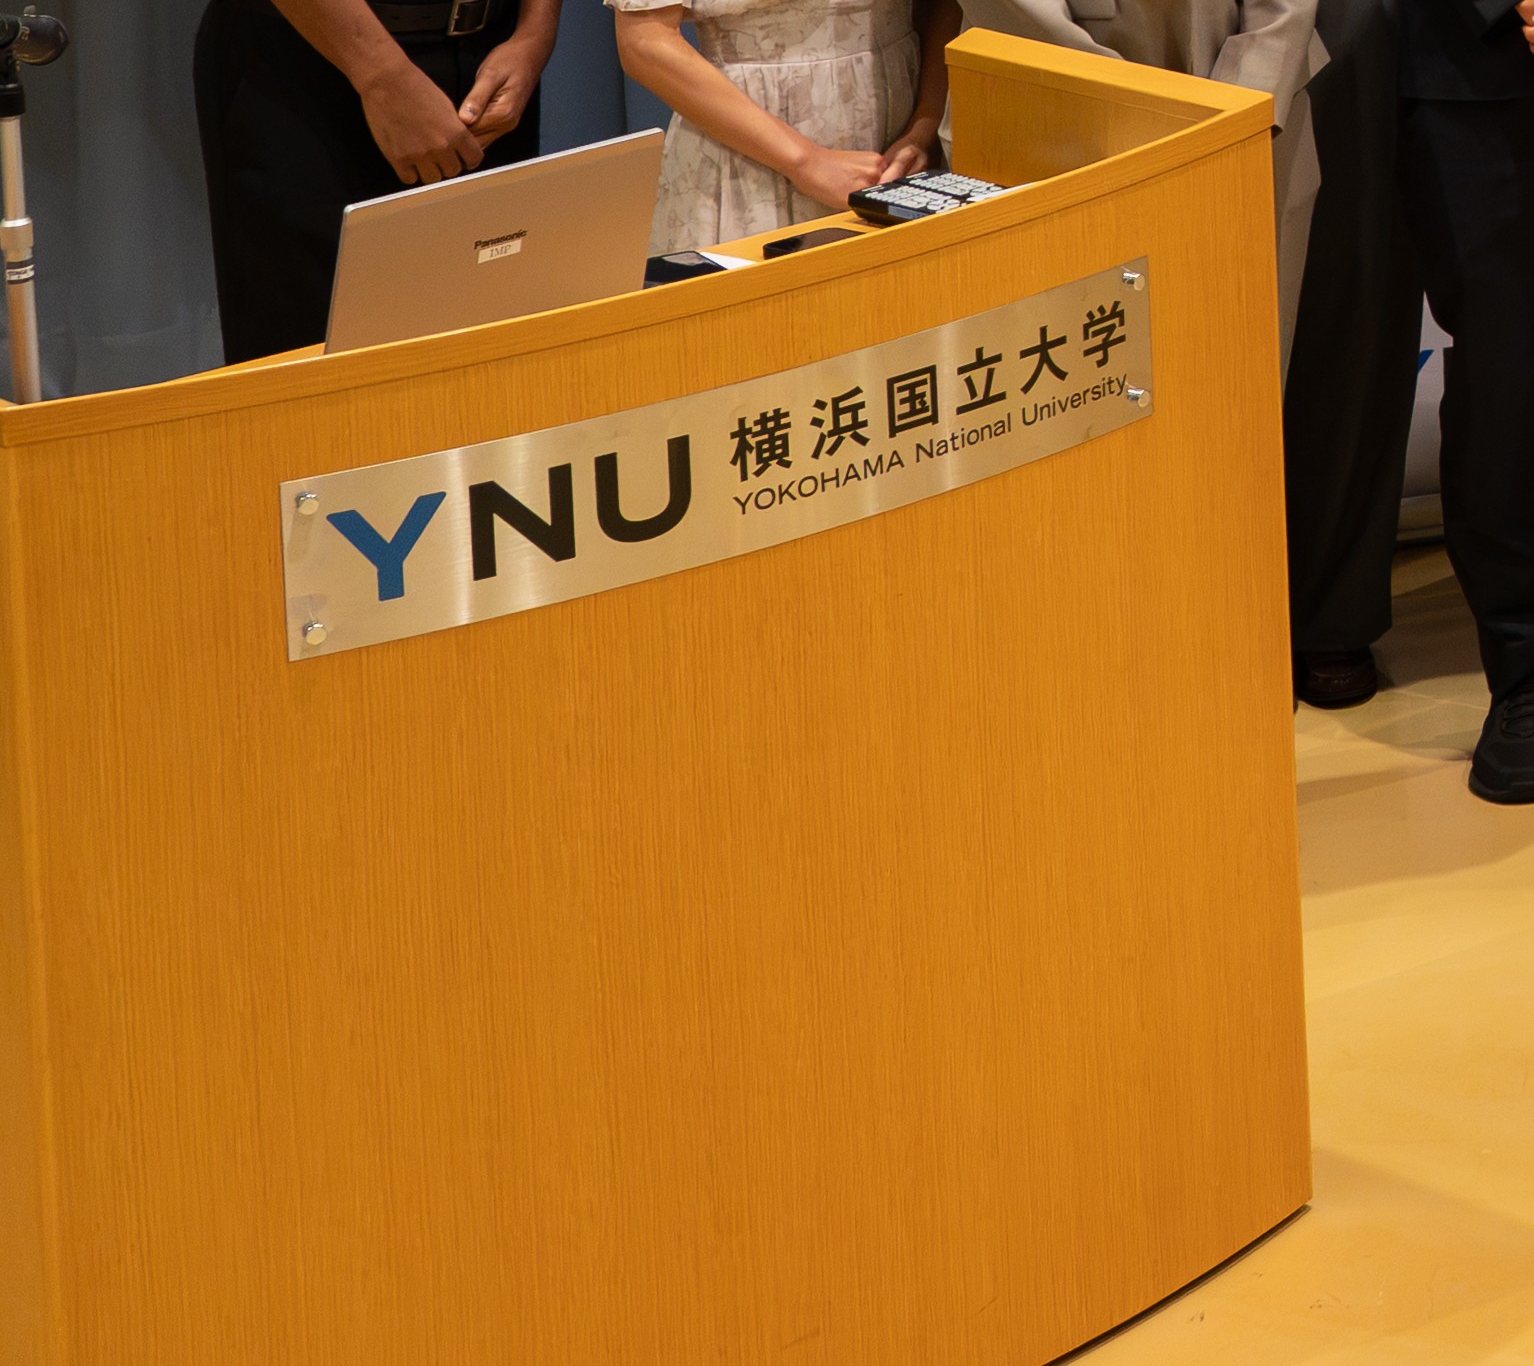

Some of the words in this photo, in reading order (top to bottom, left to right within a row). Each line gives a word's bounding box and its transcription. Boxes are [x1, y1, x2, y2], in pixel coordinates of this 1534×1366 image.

[474, 229, 527, 249] Panasonic
[490, 245, 511, 257] IMP
[729, 300, 1128, 482] 横浜国立大学
[733, 451, 905, 516] YOKOHAMA
[915, 413, 1012, 464] National
[1021, 372, 1129, 425] University
[328, 434, 692, 602] YNU
